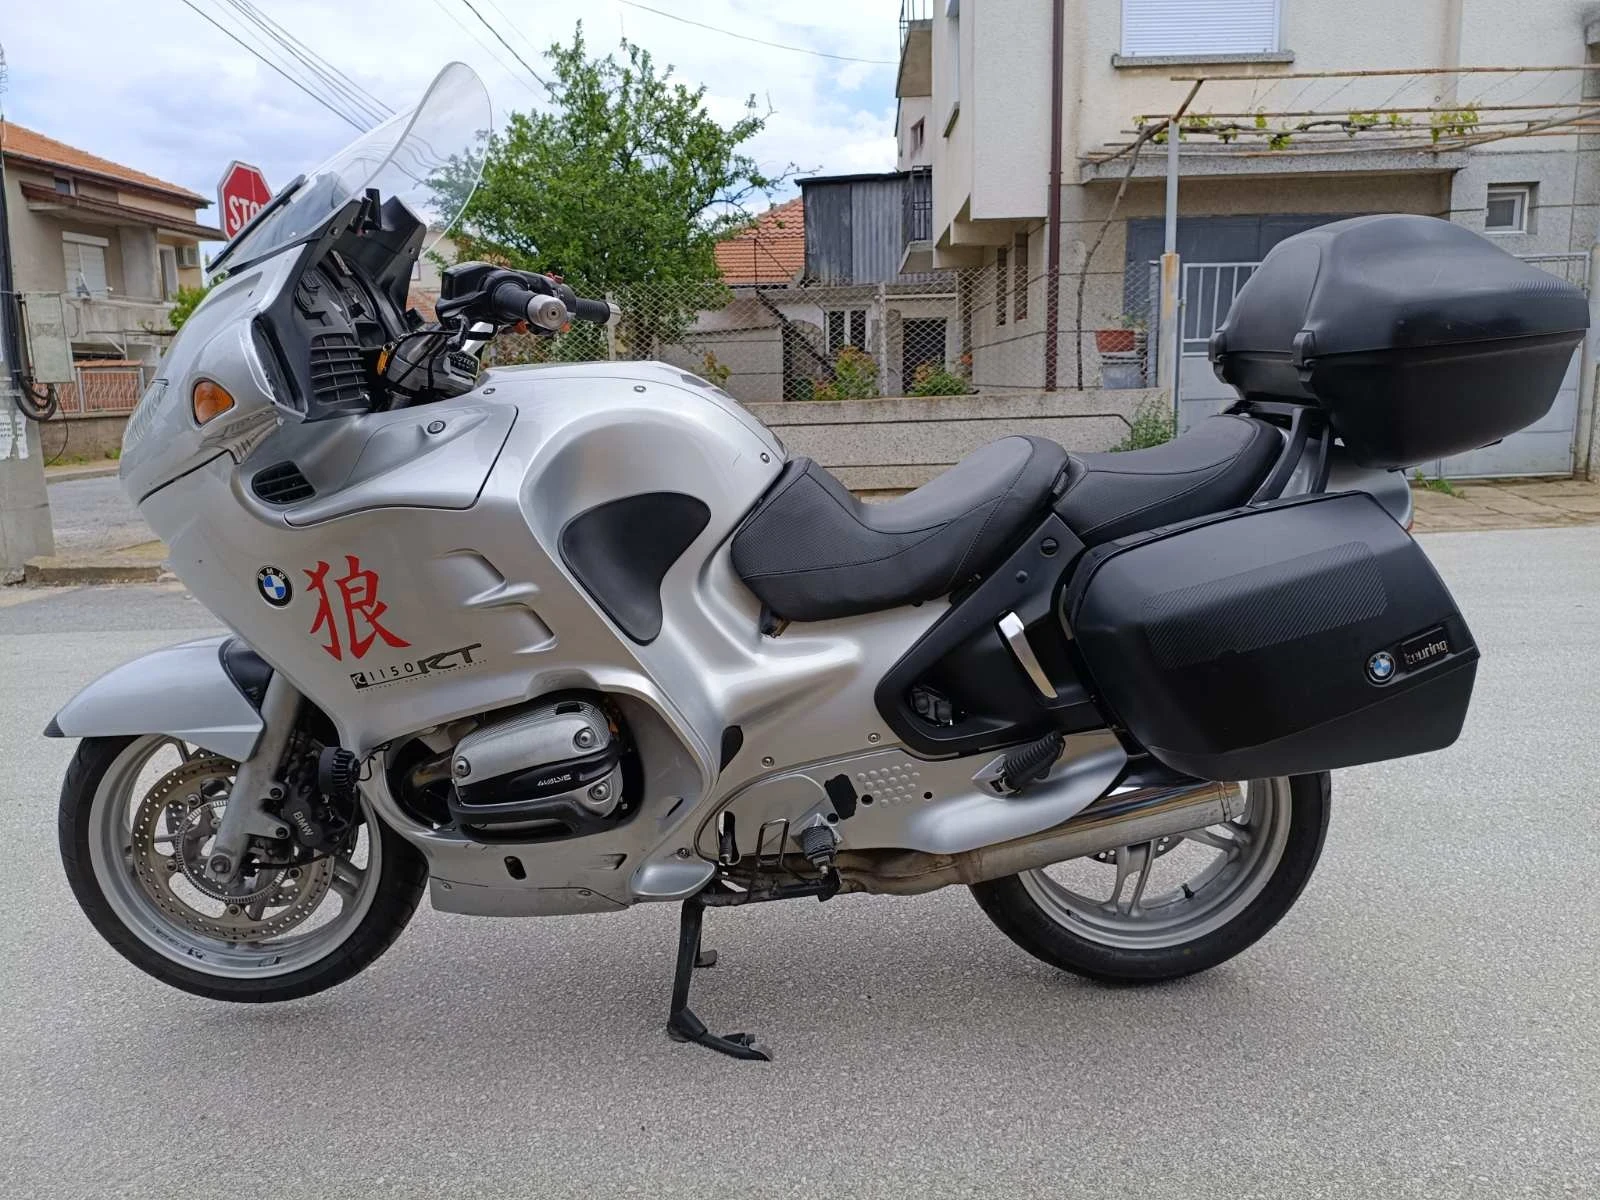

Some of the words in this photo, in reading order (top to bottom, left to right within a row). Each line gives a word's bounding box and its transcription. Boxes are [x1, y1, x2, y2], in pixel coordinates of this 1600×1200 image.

[229, 194, 264, 231] STO
[258, 567, 285, 581] BMW
[302, 555, 411, 661] 狼
[1404, 640, 1449, 665] touring
[292, 811, 314, 836] BMW
